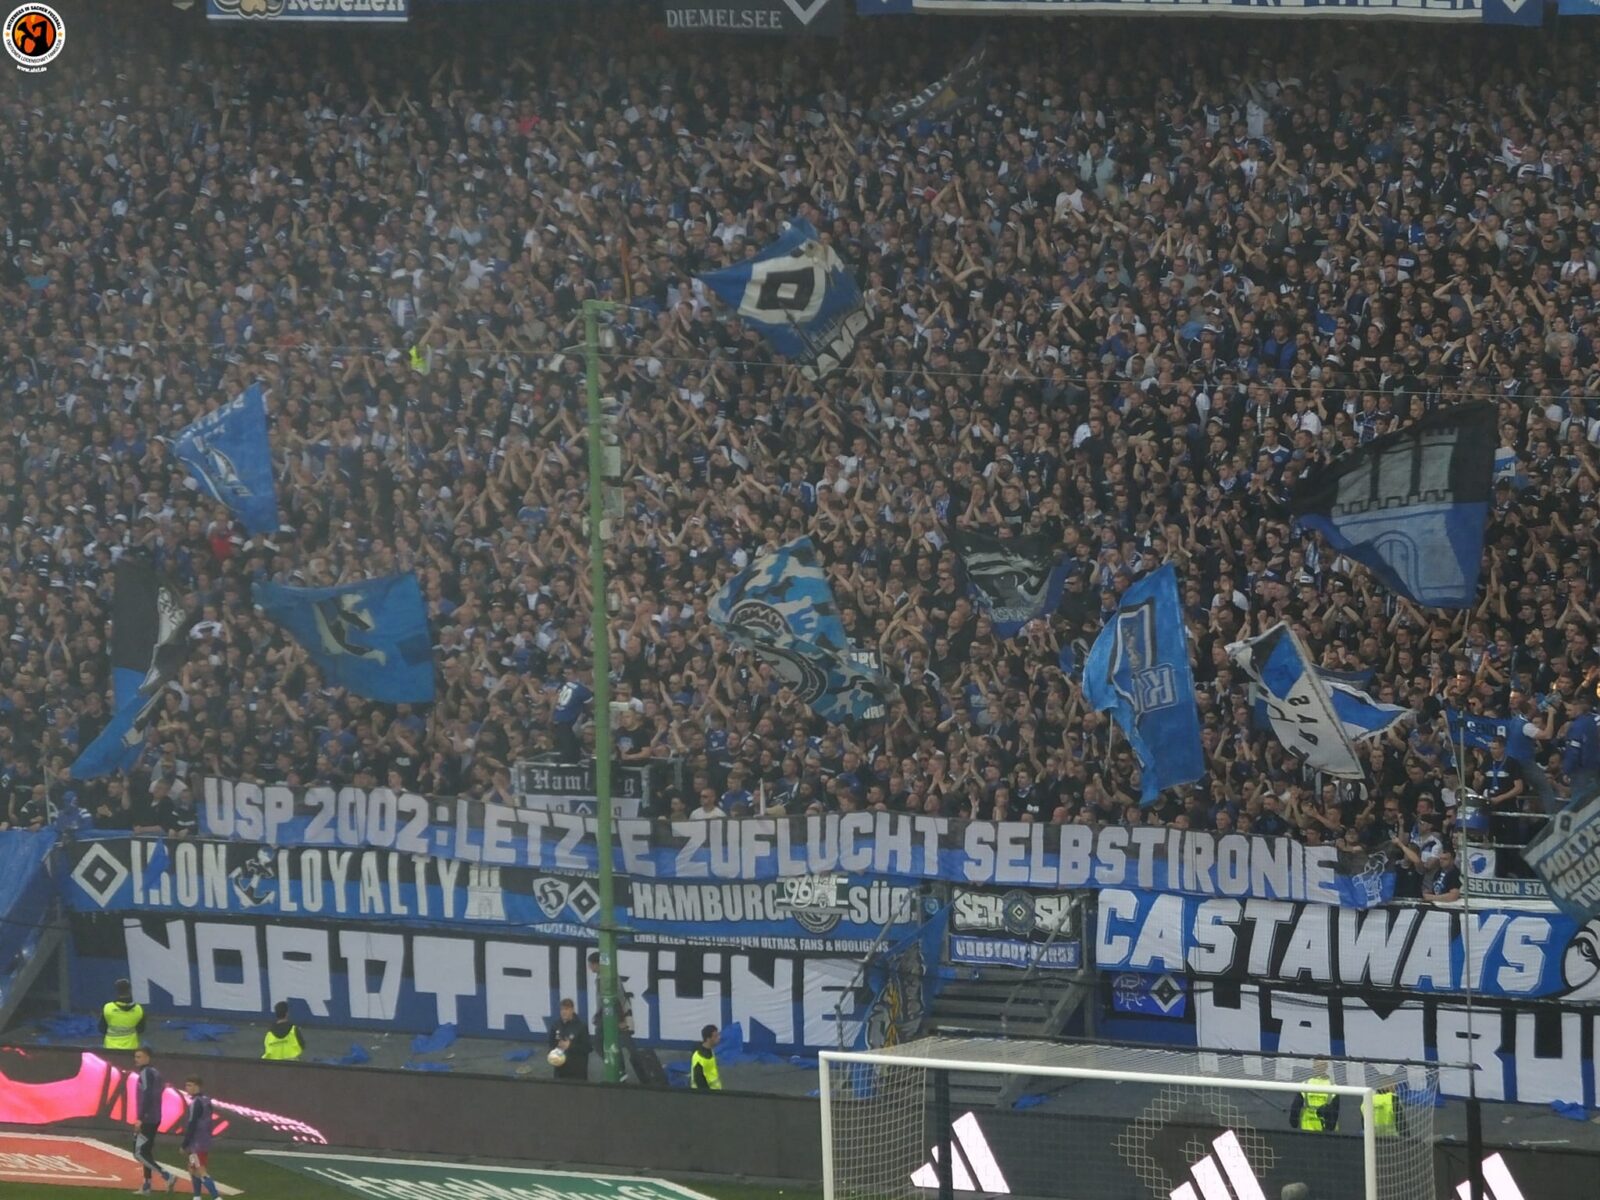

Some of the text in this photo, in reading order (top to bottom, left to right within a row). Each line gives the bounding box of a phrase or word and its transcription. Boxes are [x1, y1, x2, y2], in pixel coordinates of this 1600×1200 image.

[666, 9, 783, 28] DIEMELSEE
[532, 769, 635, 797] Hamg
[204, 777, 293, 842] USP
[671, 811, 948, 879] ZUFLUCHT
[963, 821, 1341, 903] SELBSTIRONIE
[278, 848, 459, 918] LOYALTY
[632, 881, 785, 921] HAMBURG
[1469, 880, 1520, 895] SEKTION
[534, 923, 600, 938] HOOLIGAN
[800, 938, 824, 951] FANS
[826, 940, 834, 951] &
[1096, 888, 1551, 995] CASTAWAYS
[124, 918, 865, 1047] NORDTRIBÜNE
[1194, 981, 1600, 1105] HAMBU
